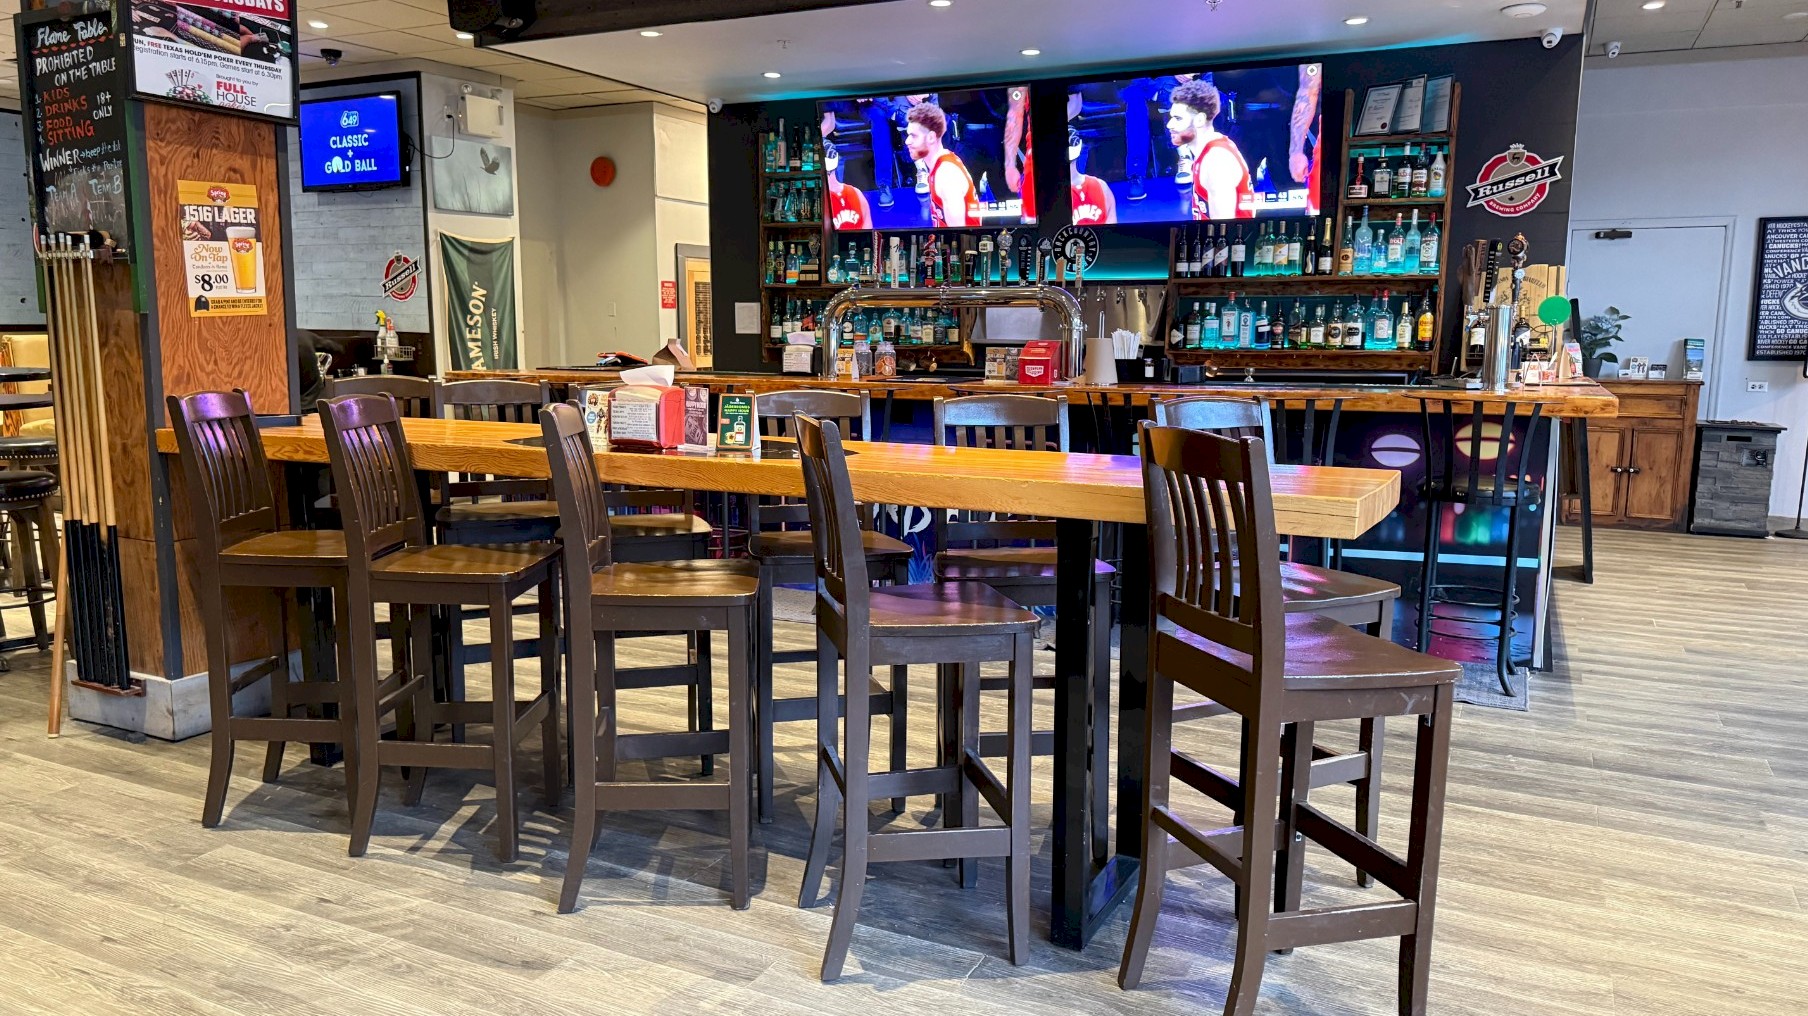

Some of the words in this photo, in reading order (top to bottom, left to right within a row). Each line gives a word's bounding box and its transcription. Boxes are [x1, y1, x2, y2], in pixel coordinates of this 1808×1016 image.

[37, 26, 71, 48] Flame
[73, 18, 109, 41] Table
[36, 46, 94, 76] PROHIBITED
[147, 41, 161, 49] FREE
[163, 45, 183, 53] TEXAS
[213, 55, 234, 63] POKER
[235, 60, 252, 68] EVERY
[254, 63, 282, 73] THURSDAY
[220, 62, 240, 71] Games
[55, 72, 68, 86] ON
[69, 65, 88, 82] THE
[89, 57, 116, 77] TABLE
[43, 88, 70, 103] KIDS
[216, 81, 247, 95] FULL
[45, 95, 88, 116] DRINKS
[97, 91, 112, 105] 18+
[216, 90, 257, 107] HOUSE
[93, 105, 112, 120] ONLY
[46, 116, 73, 132] FOOD
[47, 119, 95, 146] SITTING
[330, 134, 369, 149] CLASSIC
[40, 147, 83, 172] WINNER
[354, 158, 378, 171] BALL
[1476, 166, 1550, 198] Russell
[1488, 201, 1514, 212] BREWING
[1515, 192, 1541, 212] COMPANY
[184, 205, 212, 221] 1516
[214, 207, 257, 224] LAGER
[194, 243, 222, 253] Now
[191, 252, 207, 262] On
[209, 252, 228, 264] Tap
[194, 273, 229, 292] $8.00
[385, 264, 416, 290] Russell
[466, 284, 487, 370] AMESON
